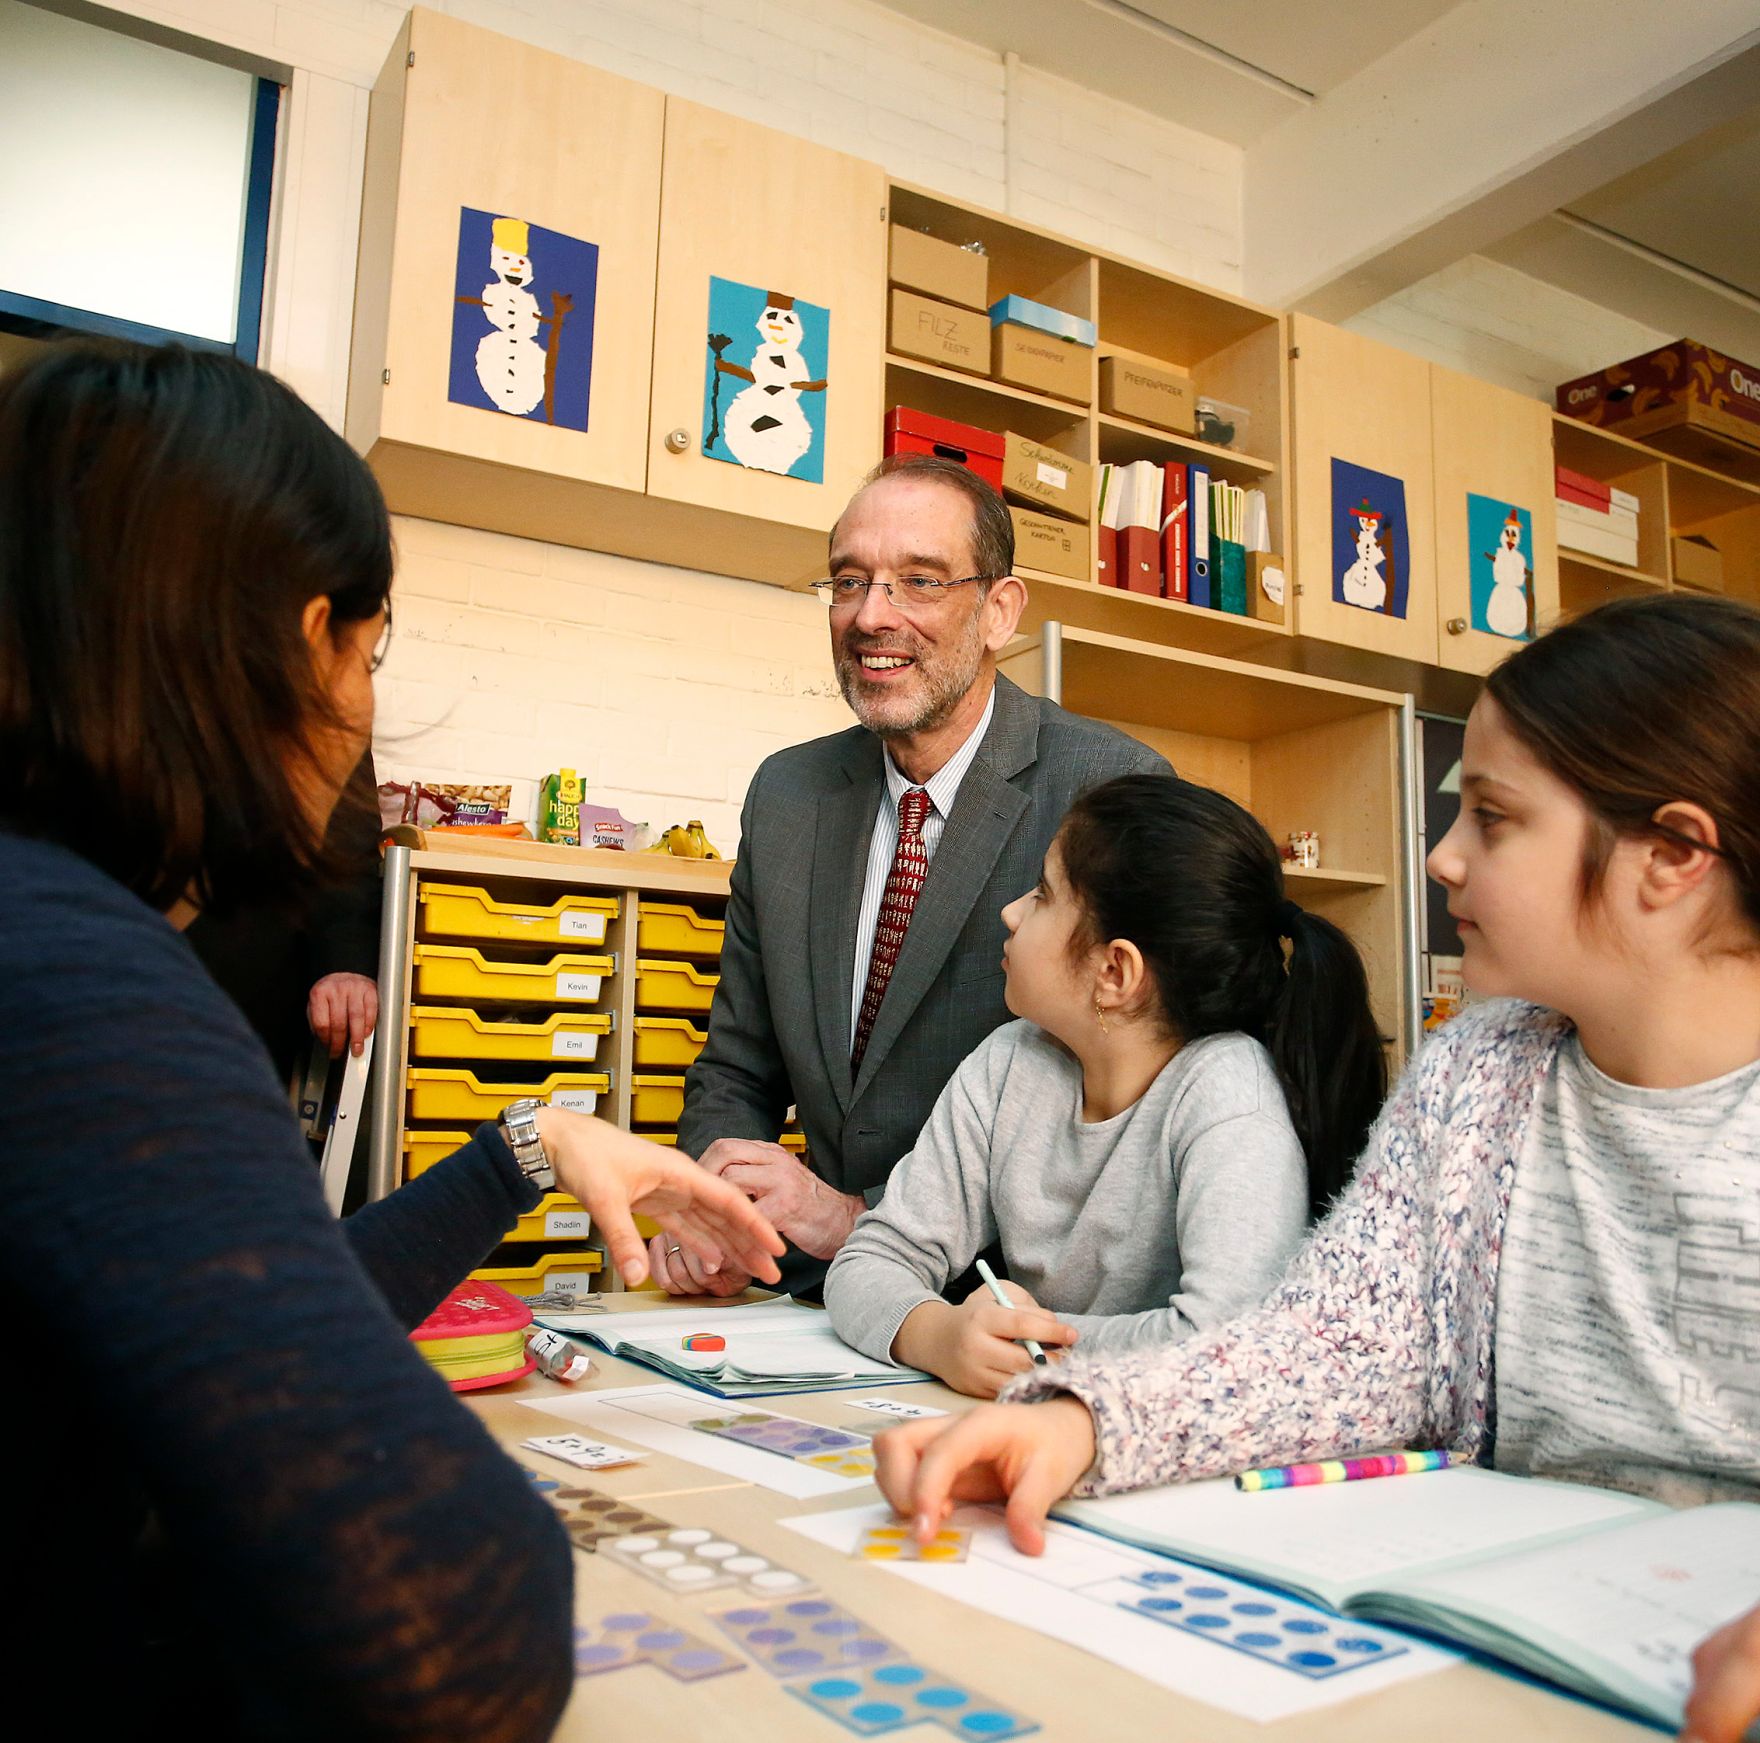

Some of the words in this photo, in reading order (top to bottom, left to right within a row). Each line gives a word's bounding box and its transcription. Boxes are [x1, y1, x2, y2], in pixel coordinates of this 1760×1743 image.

[918, 310, 959, 342] FILZ
[942, 340, 971, 356] RESTE
[1730, 368, 1760, 402] One
[1568, 385, 1597, 405] One
[457, 803, 487, 813] Alesto
[549, 799, 579, 818] happ
[556, 815, 580, 831] day
[592, 834, 625, 847] CASHEWS
[571, 921, 588, 930] Tian
[567, 982, 588, 992] Kevin
[566, 1041, 583, 1049] Emil
[560, 1099, 585, 1108] Kenan
[555, 1282, 576, 1290] David
